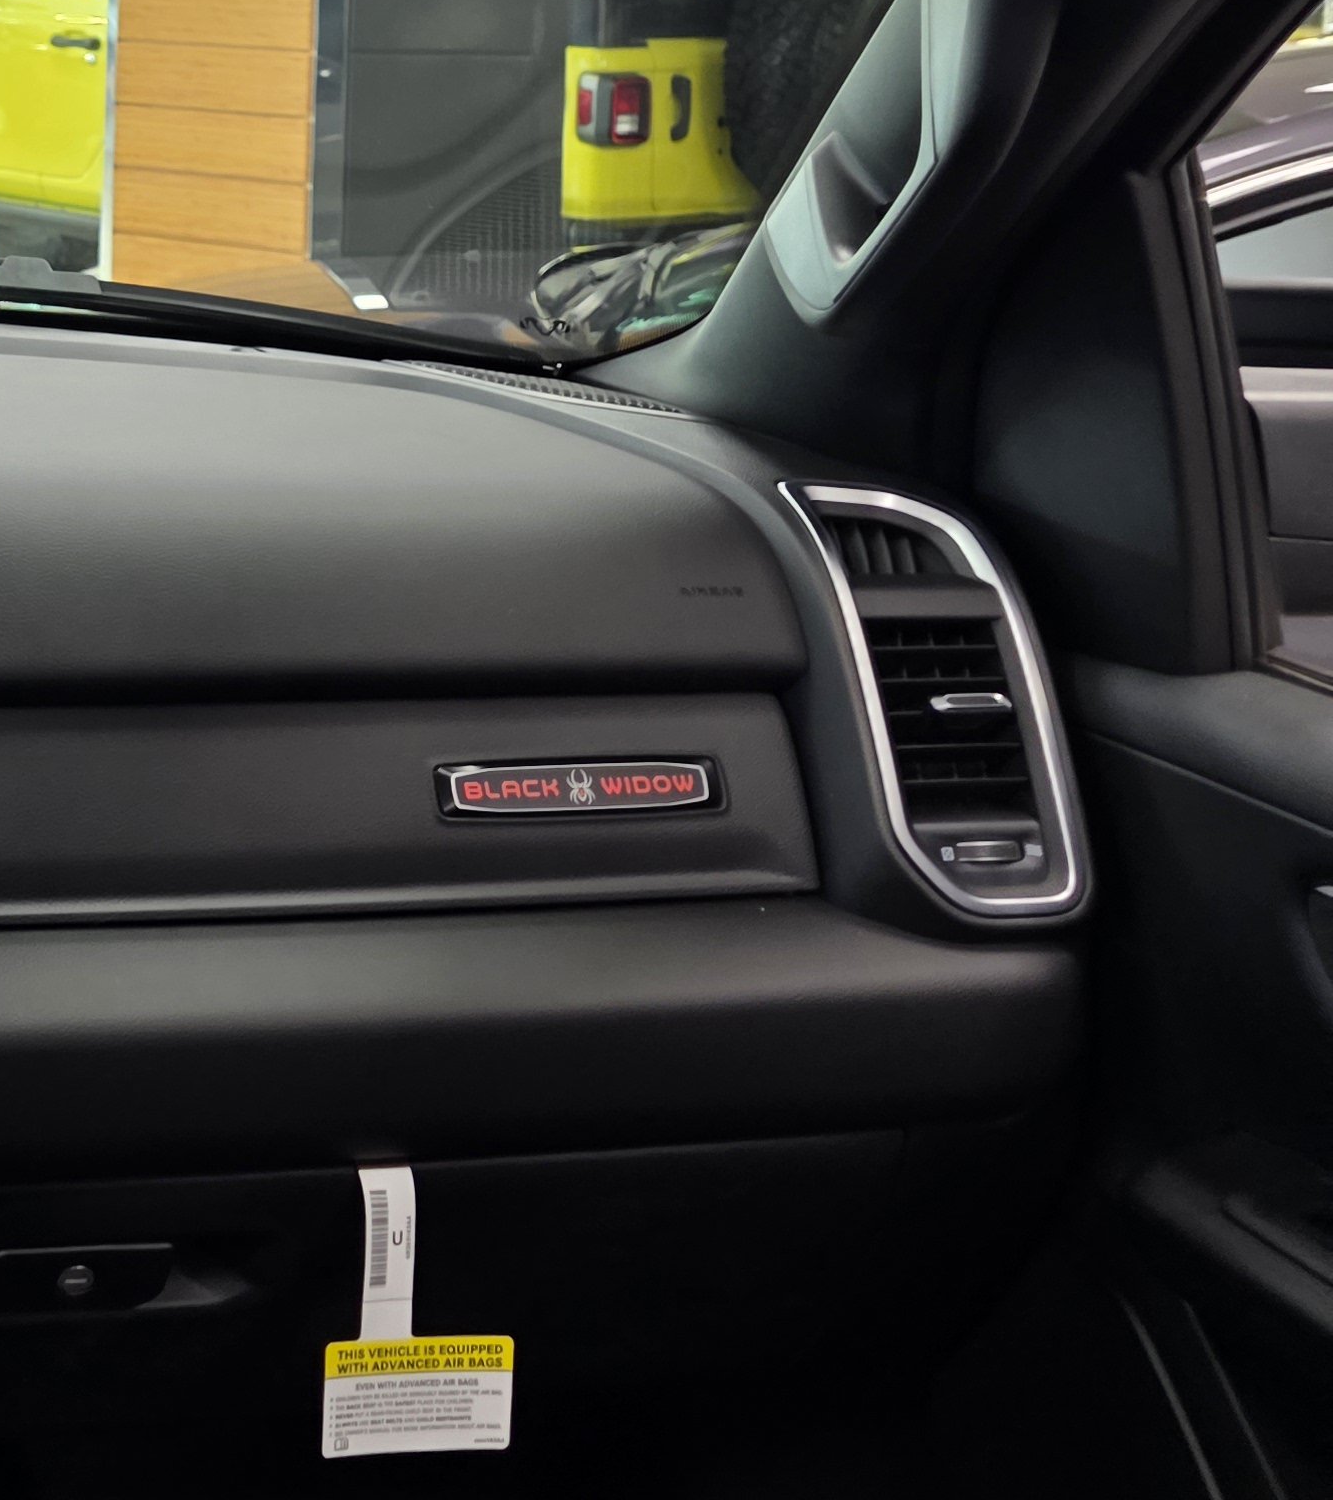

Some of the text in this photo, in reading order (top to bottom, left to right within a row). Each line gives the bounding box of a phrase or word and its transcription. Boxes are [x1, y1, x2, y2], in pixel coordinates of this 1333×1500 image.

[463, 774, 694, 800] BLACK WIDOW
[393, 1230, 403, 1246] U
[337, 1343, 504, 1361] THIS VEHICLE IS EQUIPPED
[337, 1356, 504, 1375] WITH ADVANCED AIR BAGS
[355, 1378, 479, 1391] EVEN WITH ADVANCED AIR BAGS
